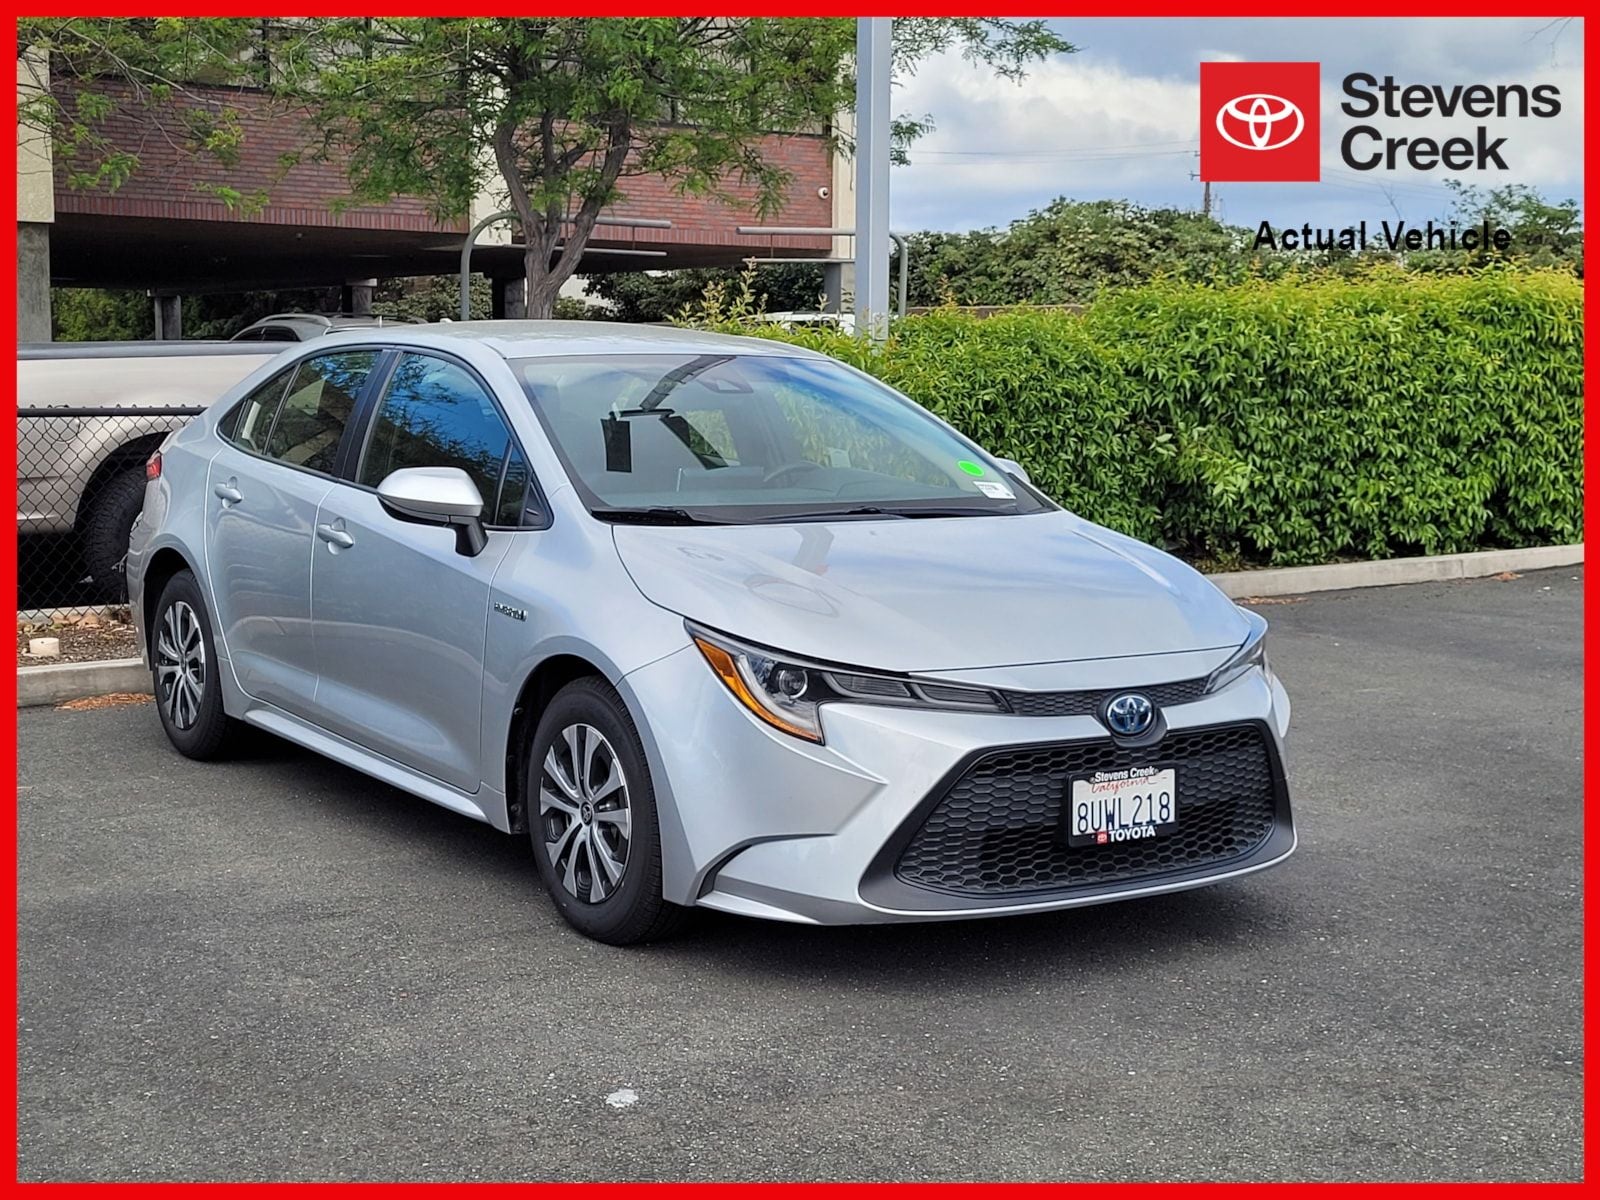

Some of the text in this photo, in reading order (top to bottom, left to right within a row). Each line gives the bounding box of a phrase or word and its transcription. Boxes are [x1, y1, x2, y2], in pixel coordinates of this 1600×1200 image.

[1094, 766, 1155, 782] Stevens Creek
[1078, 791, 1170, 833] 8UWL218
[1109, 825, 1156, 842] TOYOTA
